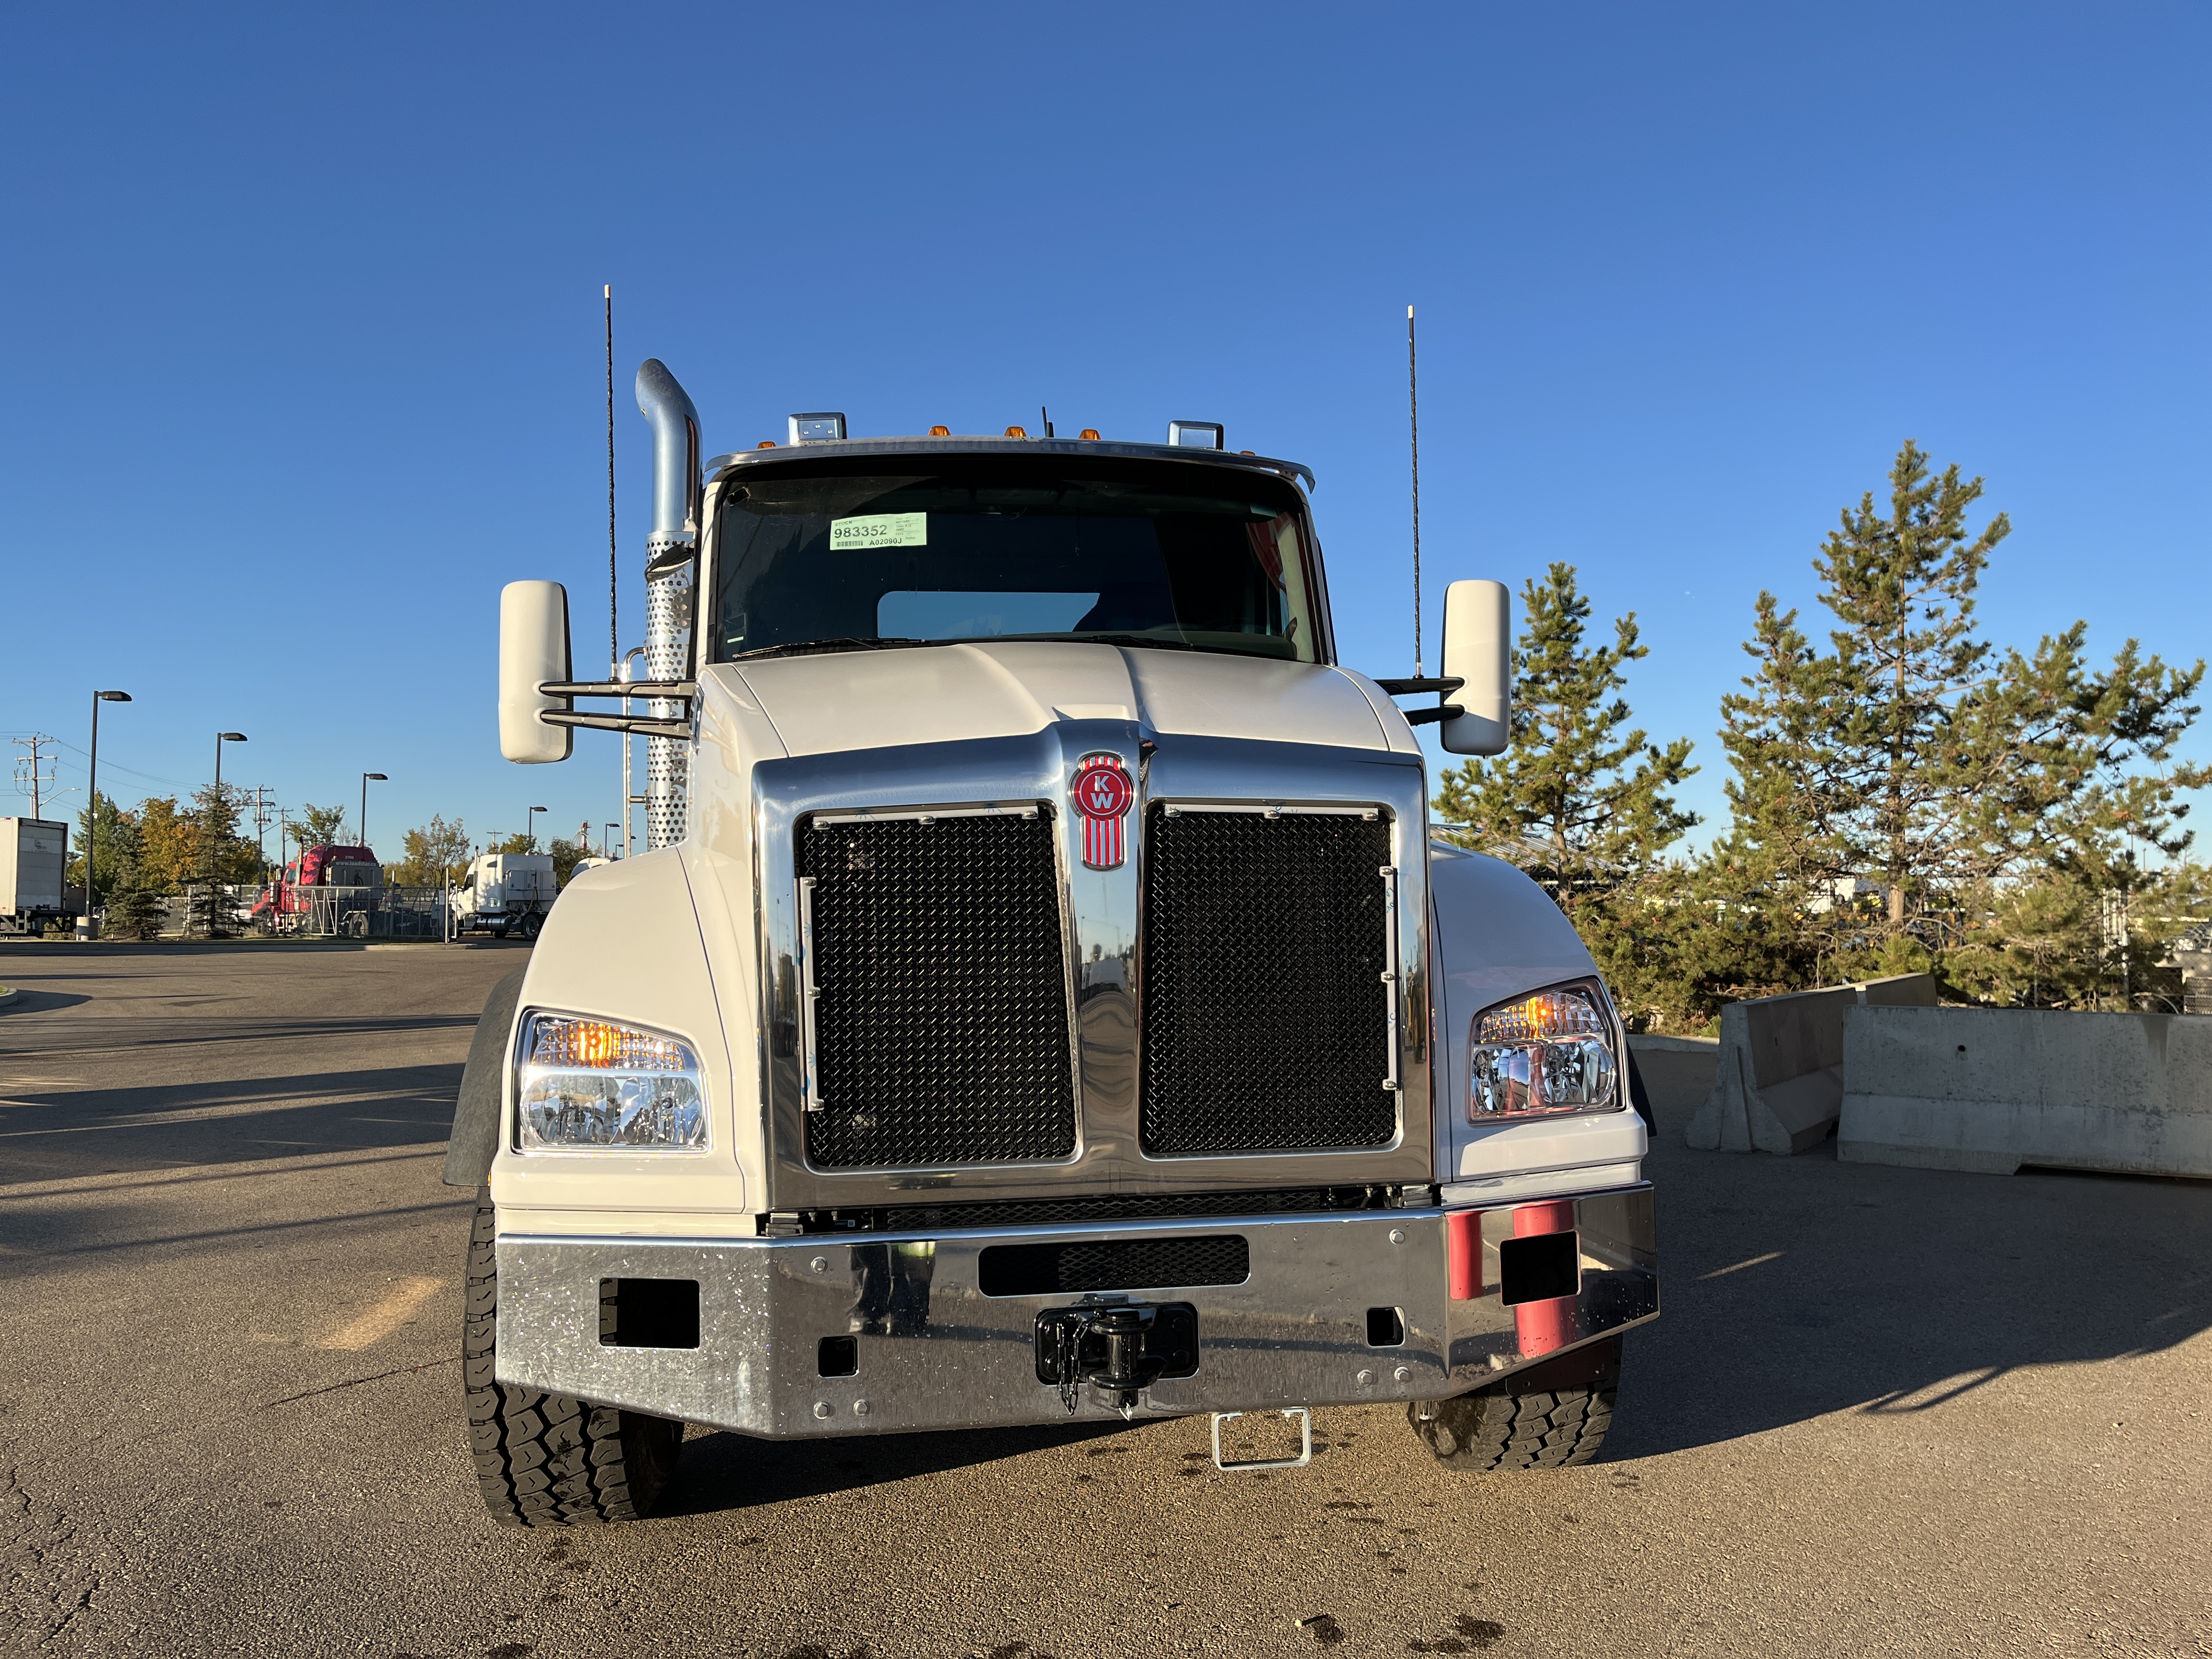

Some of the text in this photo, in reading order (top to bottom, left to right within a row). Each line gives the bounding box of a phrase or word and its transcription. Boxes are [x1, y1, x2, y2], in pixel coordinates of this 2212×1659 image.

[834, 524, 887, 538] 983352
[870, 538, 901, 546] A02090J
[1094, 775, 1110, 792] K
[1090, 792, 1114, 809] W
